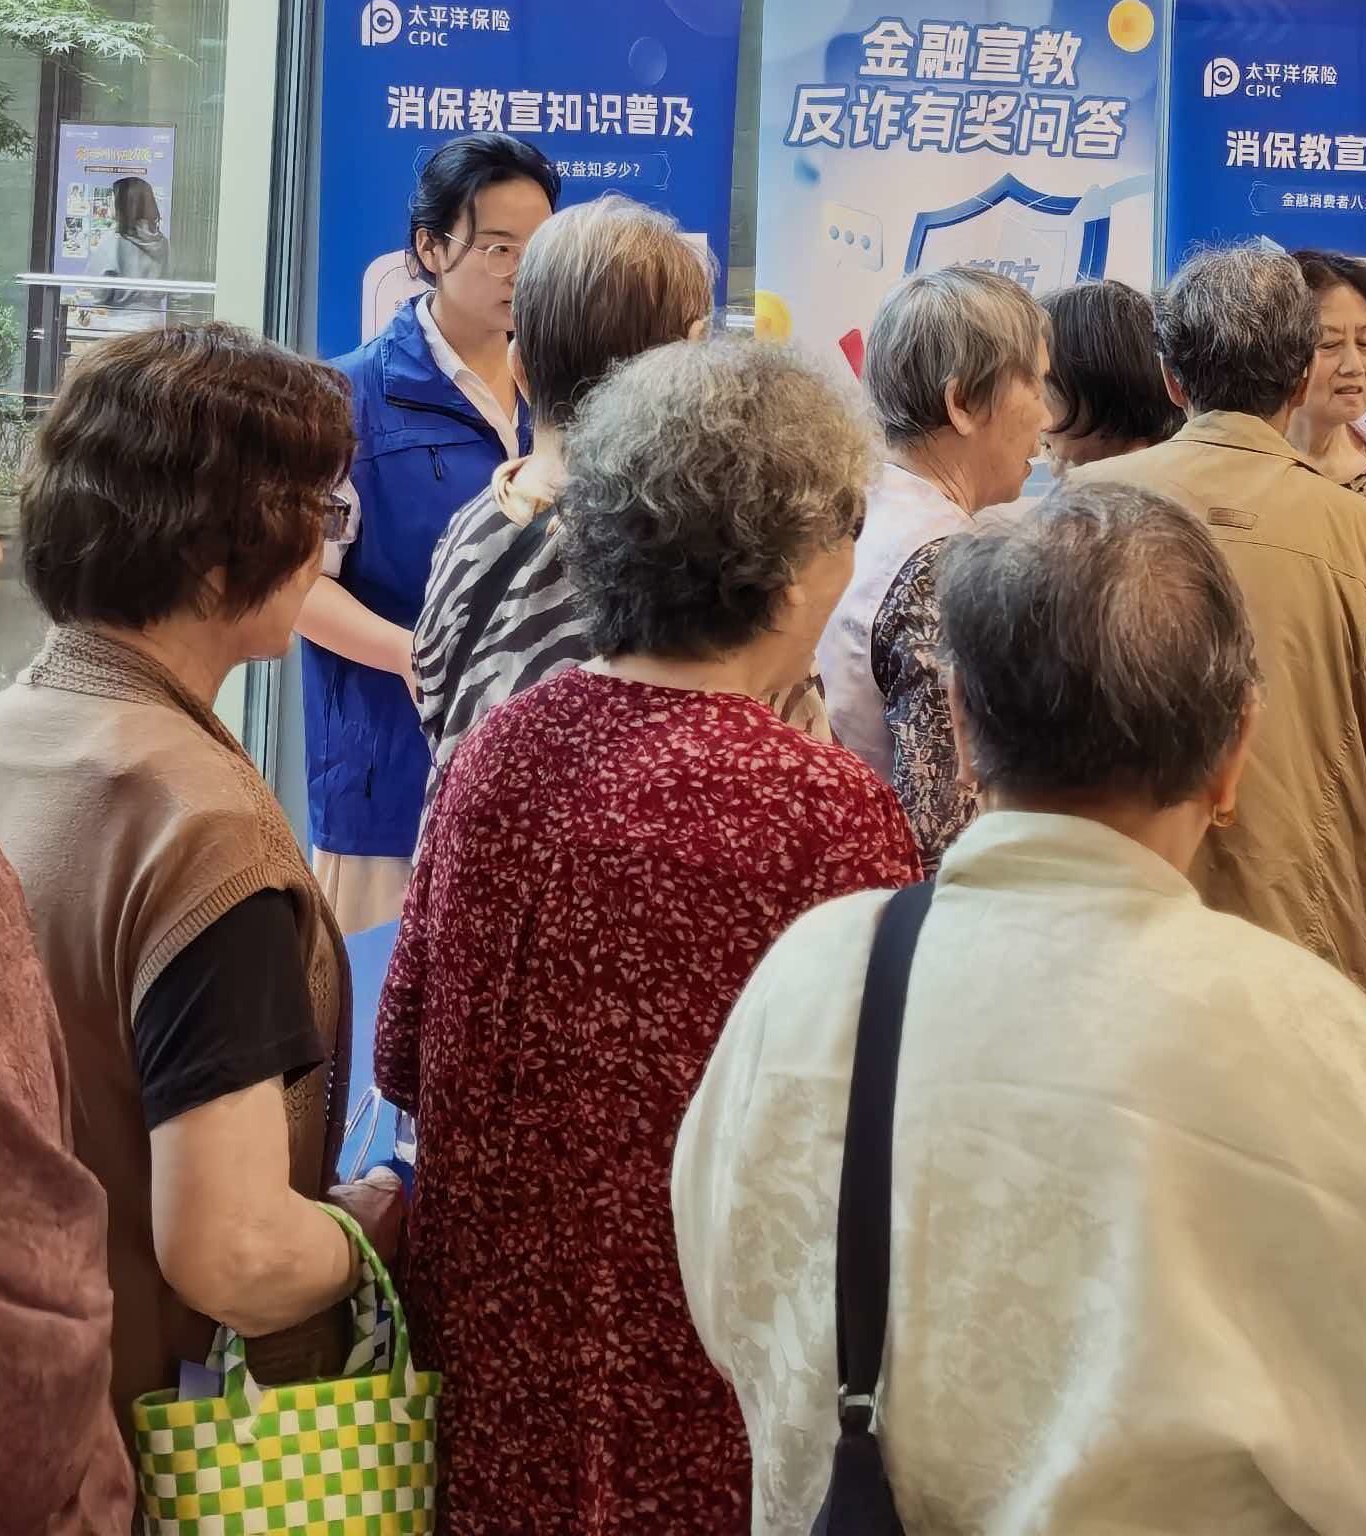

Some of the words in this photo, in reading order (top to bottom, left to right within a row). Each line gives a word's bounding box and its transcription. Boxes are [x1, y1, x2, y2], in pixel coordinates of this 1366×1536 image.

[408, 5, 511, 32] 太平洋保险
[408, 31, 448, 48] CPIC
[859, 21, 1082, 88] 金融宣教
[1245, 62, 1337, 85] 太平洋保险
[1245, 84, 1282, 98] CPIC
[387, 86, 693, 137] 消保教宣知识普及
[788, 88, 1127, 156] 反诈有奖问答
[546, 160, 641, 178] 权益知多少?
